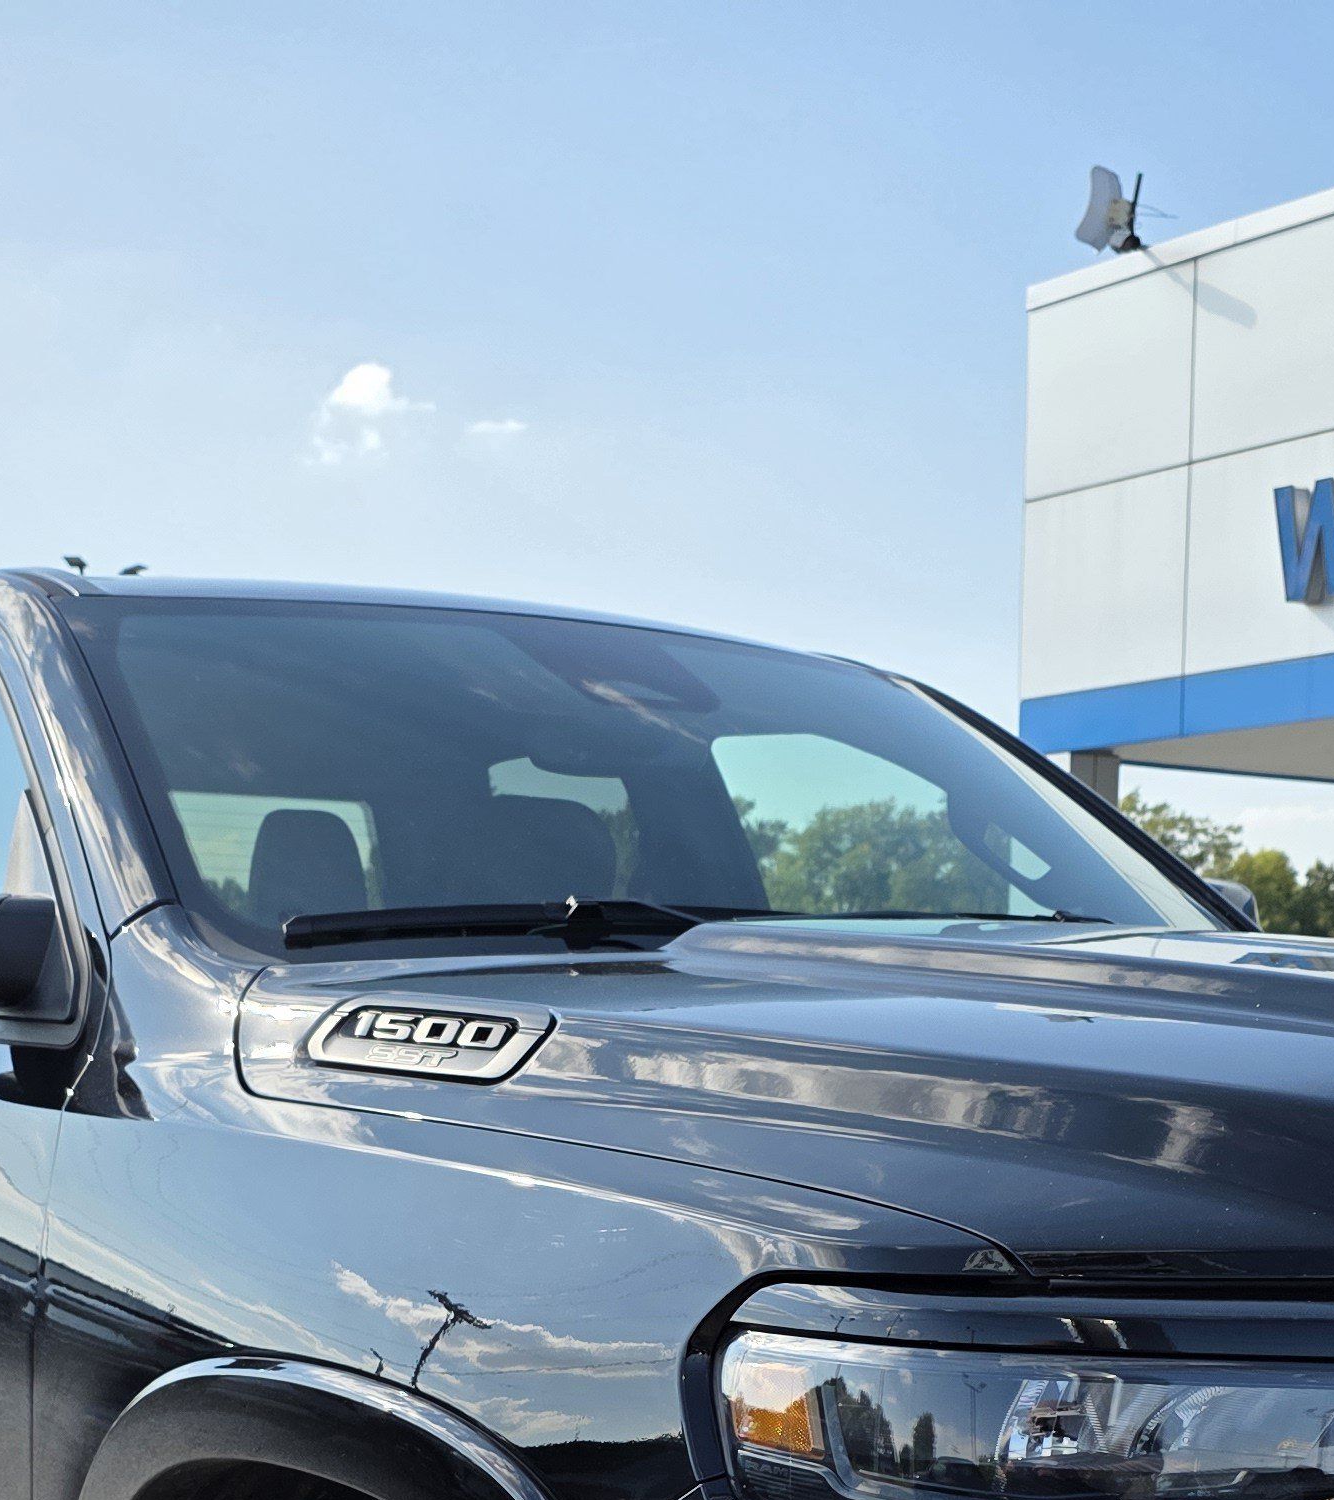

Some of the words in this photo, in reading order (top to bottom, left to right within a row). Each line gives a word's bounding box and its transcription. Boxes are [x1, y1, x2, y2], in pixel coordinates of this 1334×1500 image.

[354, 1010, 513, 1050] 1500
[365, 1044, 459, 1067] SST
[745, 1459, 789, 1477] RAM
